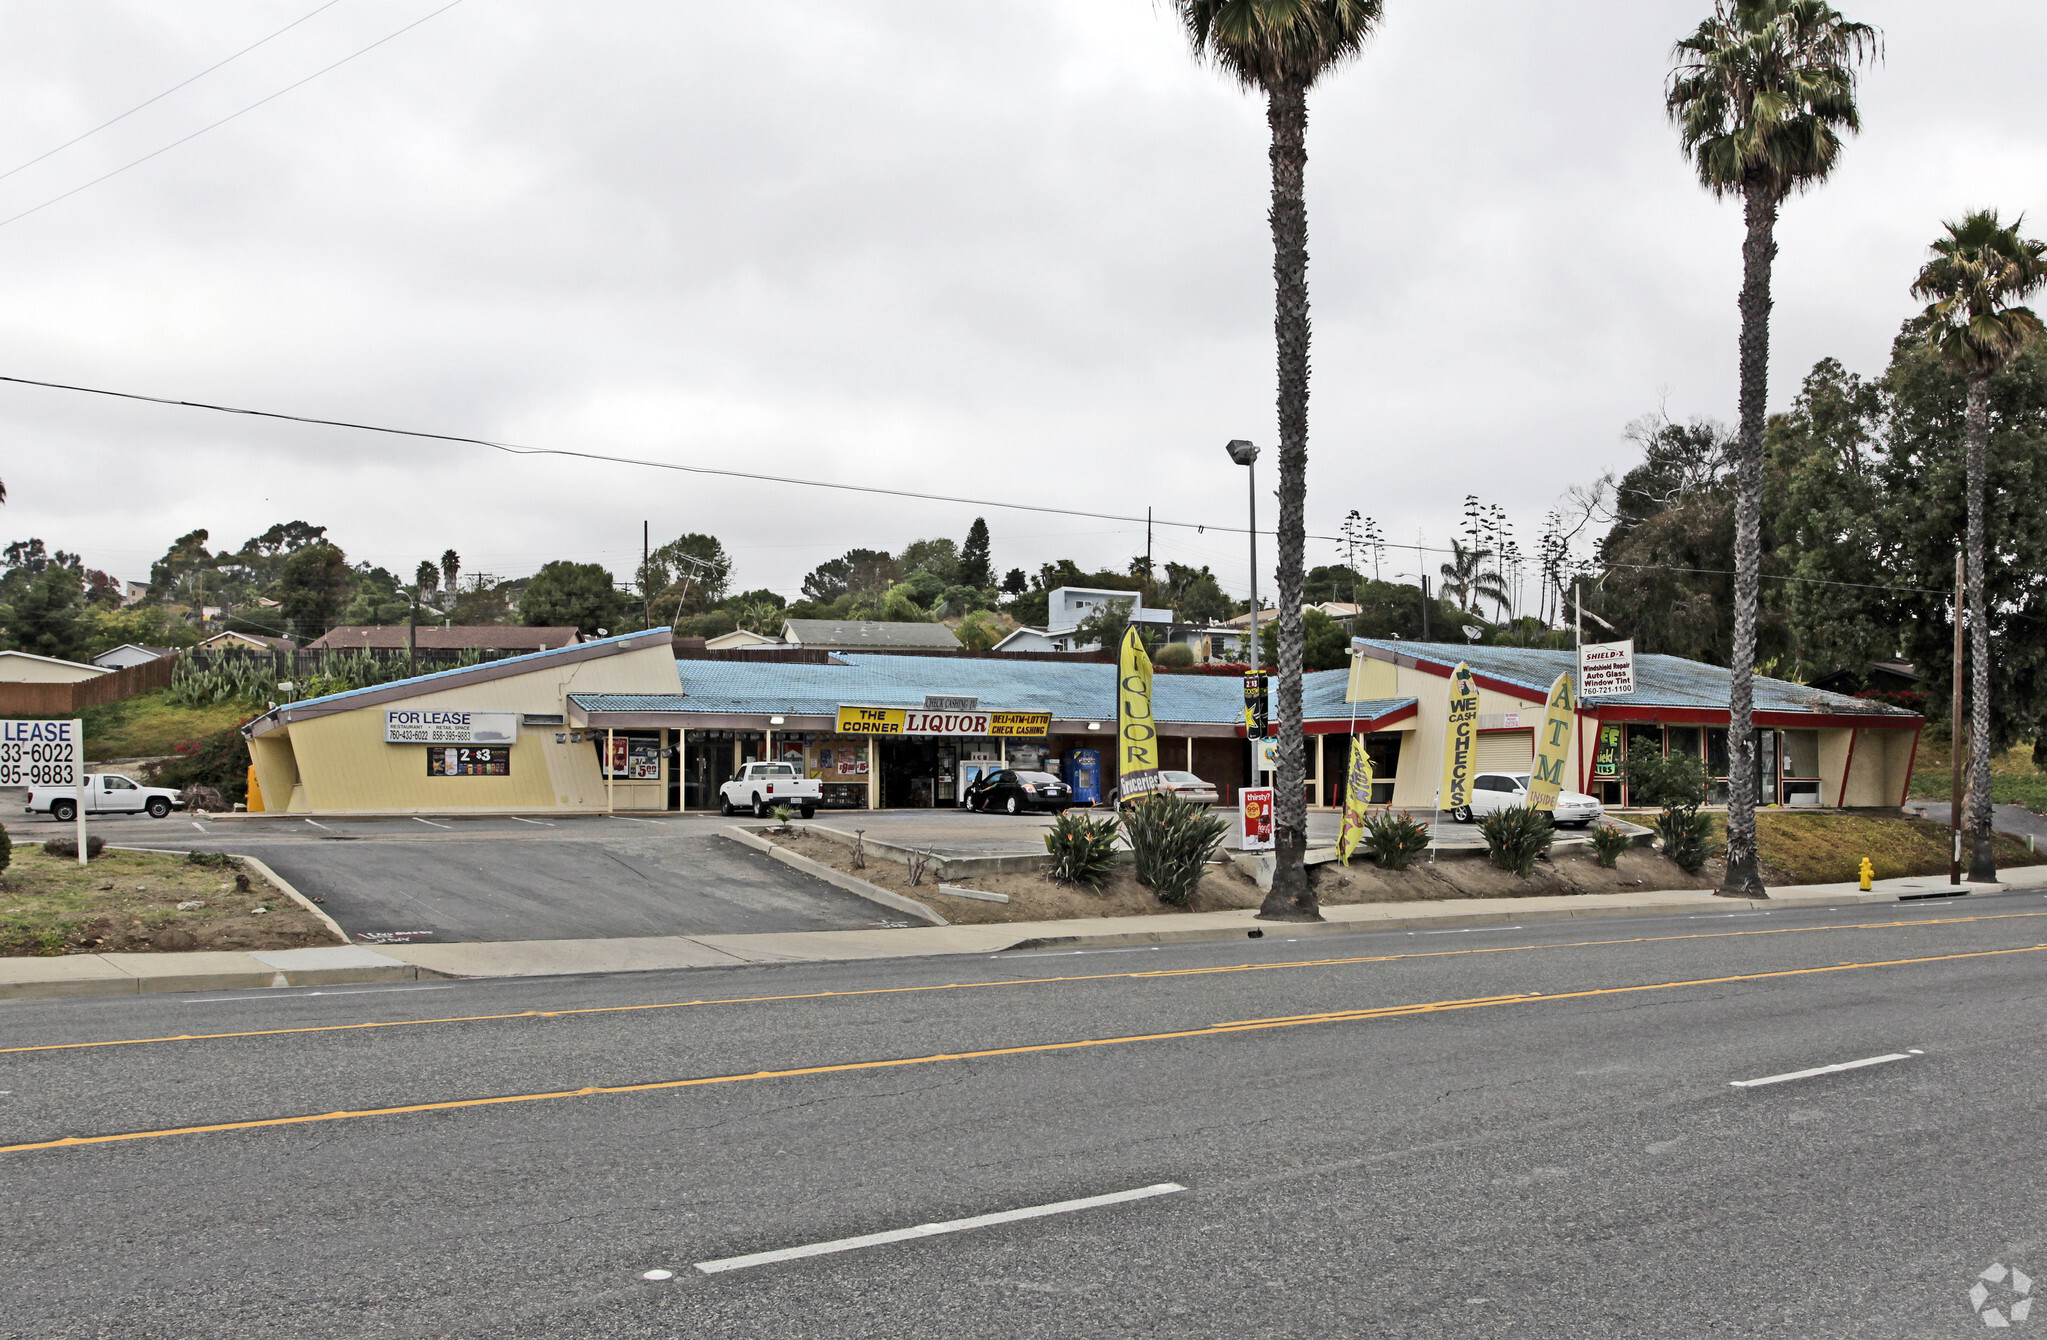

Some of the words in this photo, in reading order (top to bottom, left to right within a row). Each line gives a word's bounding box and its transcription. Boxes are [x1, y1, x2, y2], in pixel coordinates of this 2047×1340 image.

[1583, 664, 1612, 672] Windshield
[1613, 662, 1630, 670] Repair
[1584, 679, 1614, 687] Window
[1583, 685, 1632, 695] 760-721-1100
[925, 697, 944, 708] CHECK
[945, 698, 968, 709] CASHING
[1122, 631, 1155, 765] LIQUOR
[1450, 697, 1477, 713] WE
[389, 712, 420, 724] FOR
[423, 712, 471, 725] LEASE
[860, 710, 886, 720] THE
[1448, 712, 1477, 723] CASH
[843, 721, 899, 732] CORNER
[906, 714, 988, 733] LIQUOR
[991, 726, 1014, 734] CHECK
[1016, 726, 1045, 734] CASHING
[5, 722, 71, 742] LEASE
[389, 730, 429, 740] 760-433-6022
[1533, 682, 1573, 786] ATM
[1, 743, 74, 763] 33-6022
[460, 748, 471, 761] 2
[476, 748, 491, 761] $3
[1450, 722, 1470, 806] CHECKS
[0, 764, 74, 784] 95-9883
[1247, 793, 1271, 802] thirsty?
[1530, 791, 1556, 807] INSIDE
